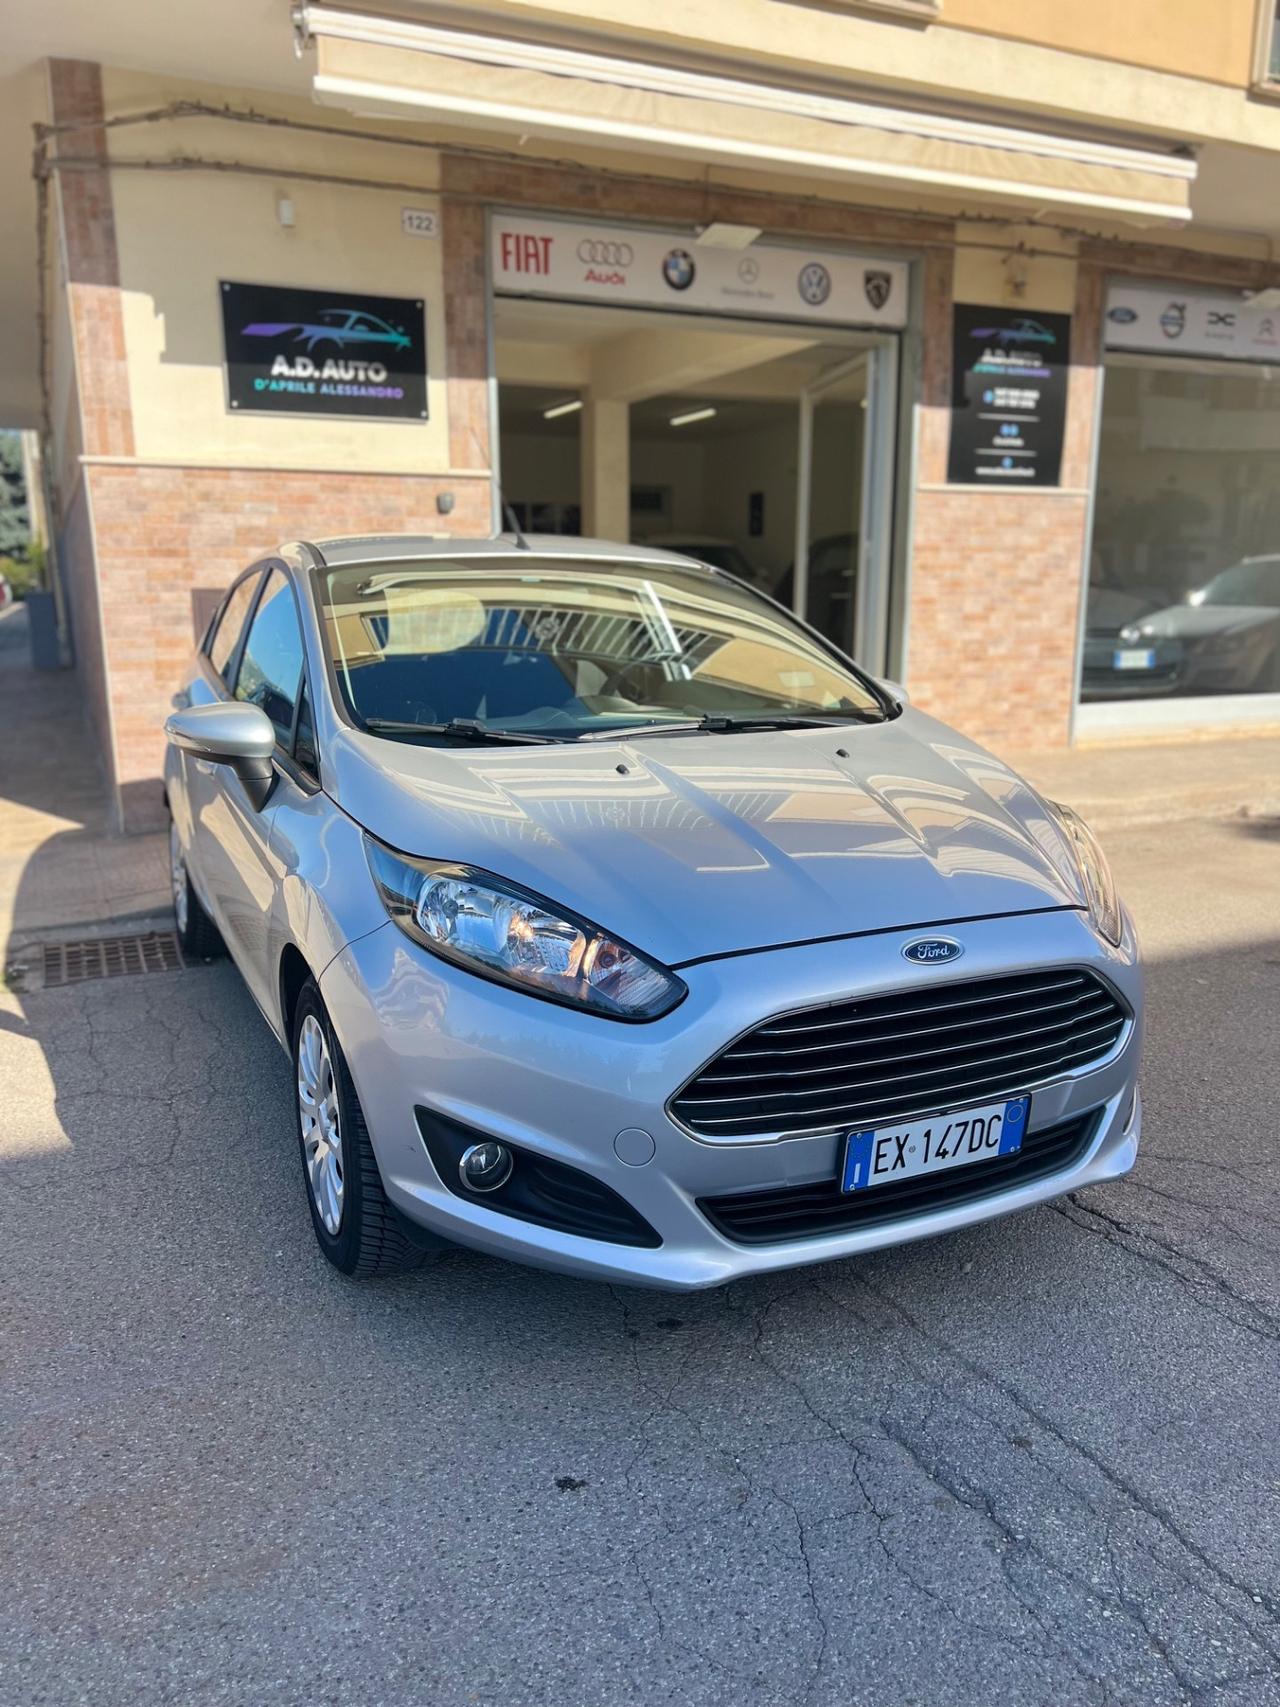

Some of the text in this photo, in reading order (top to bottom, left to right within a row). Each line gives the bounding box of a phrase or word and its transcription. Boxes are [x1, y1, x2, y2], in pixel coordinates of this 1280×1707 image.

[408, 215, 432, 232] 122
[501, 232, 553, 275] FIAT
[584, 269, 626, 285] Audi
[320, 383, 404, 399] ALESSANDRO
[918, 943, 950, 959] Ford
[873, 1133, 911, 1175] EX
[923, 1114, 1003, 1164] 147DC
